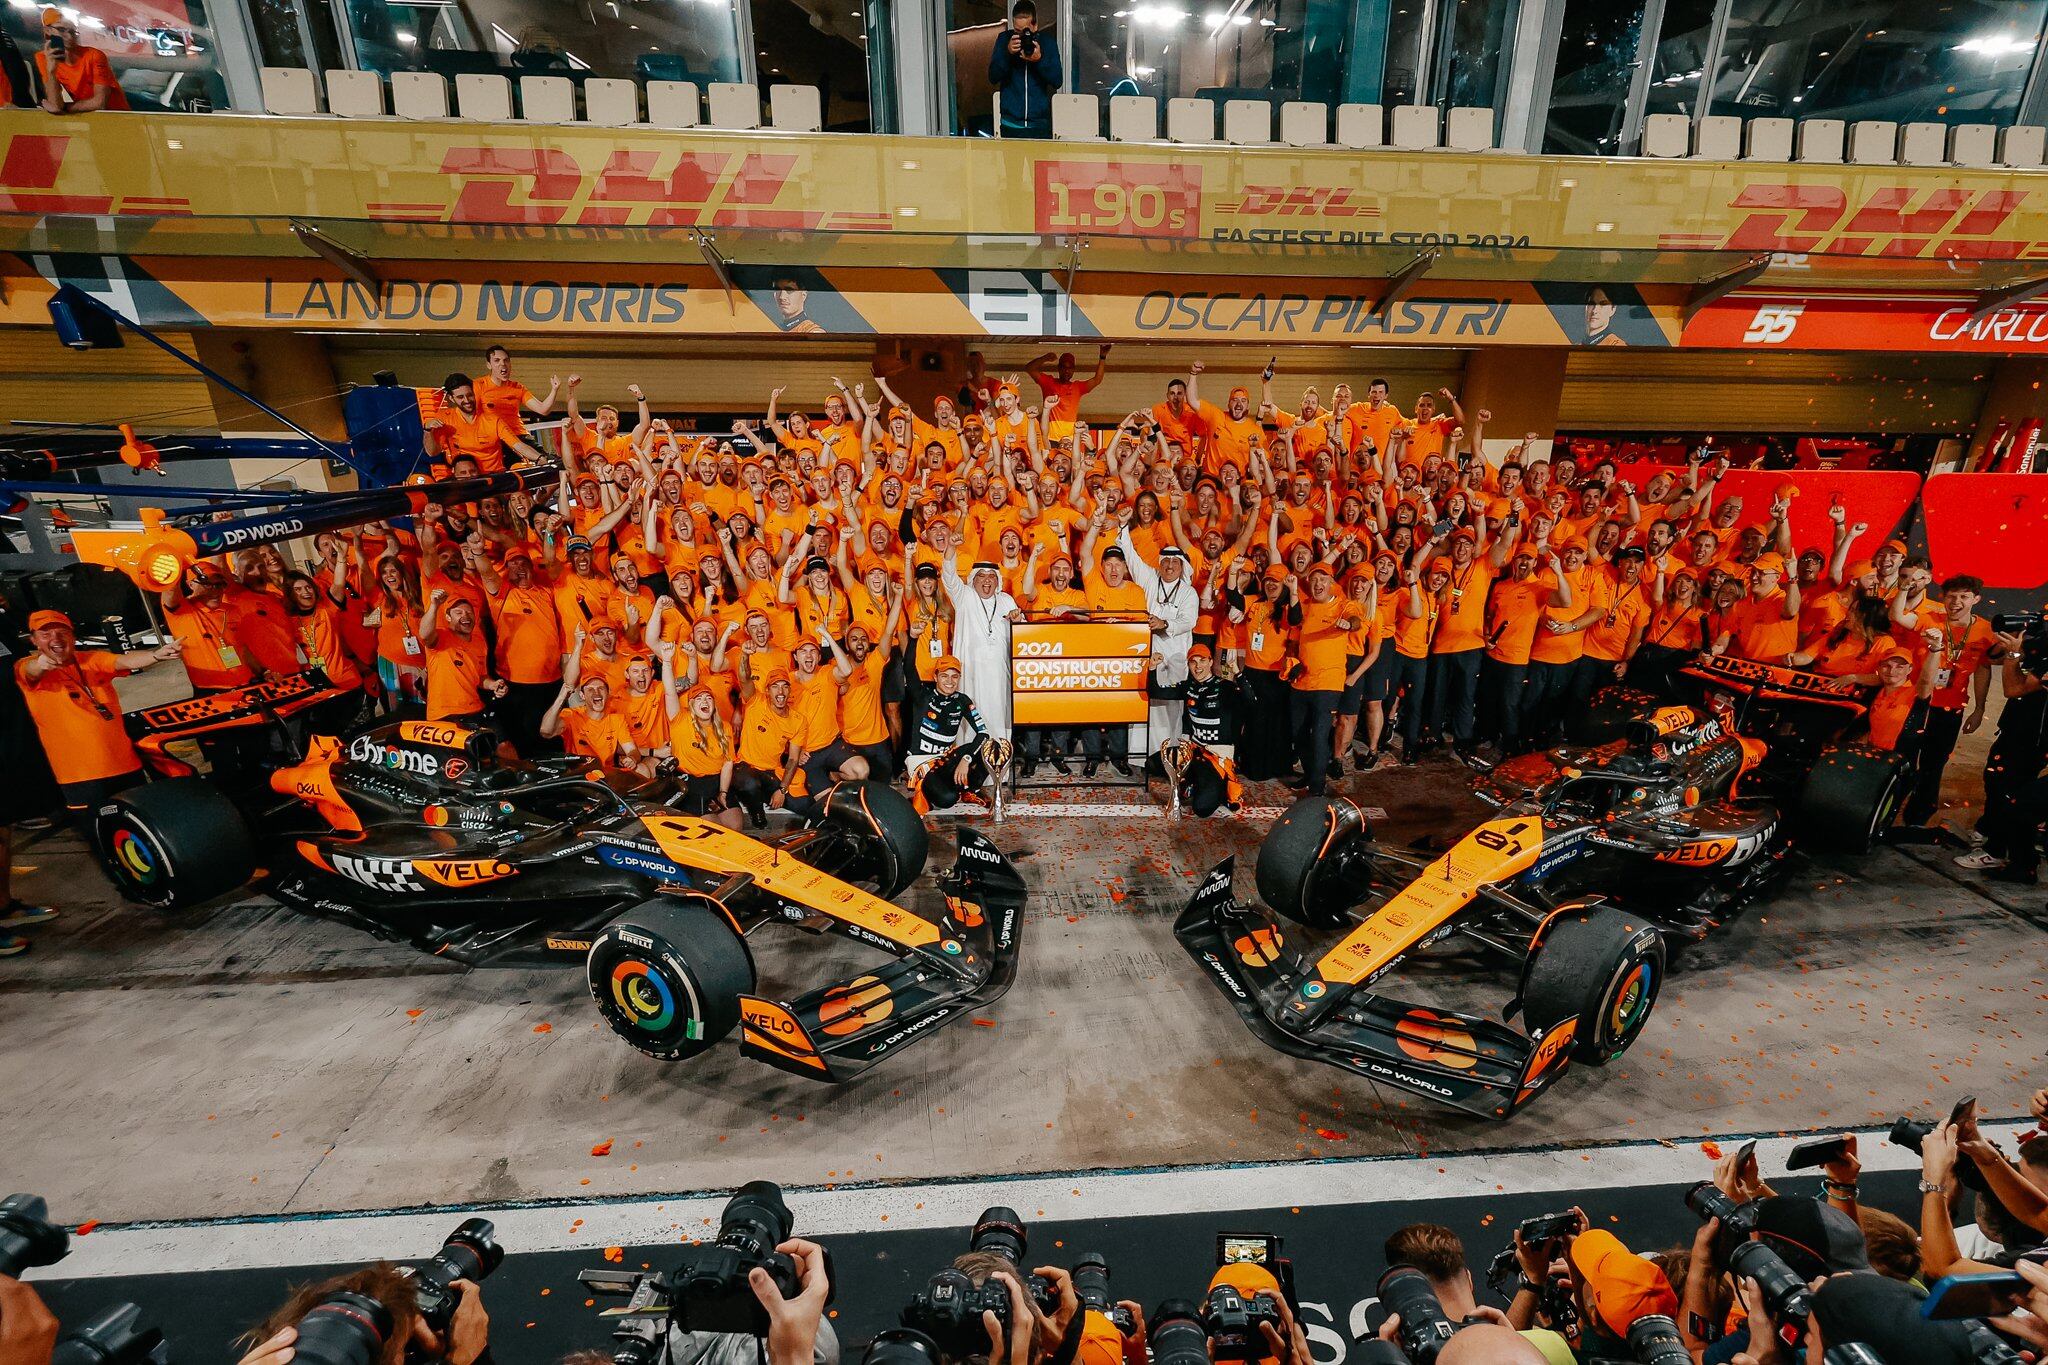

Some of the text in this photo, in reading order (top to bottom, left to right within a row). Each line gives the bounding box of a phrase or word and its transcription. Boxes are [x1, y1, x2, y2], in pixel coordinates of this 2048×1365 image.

[438, 147, 823, 229] DHL
[1237, 185, 1358, 216] DHL
[1722, 184, 2030, 259] DHL
[264, 277, 688, 323] LANDO NORRIS
[1134, 289, 1513, 336] OSCAR PIASTRI
[1743, 304, 1805, 343] 55
[223, 519, 304, 545] DP WORLD
[1017, 642, 1063, 656] 2024
[1015, 660, 1147, 675] CONSTRUCTORS'
[1015, 675, 1122, 689] CHAMPIONS
[1660, 710, 1690, 730] VELO
[413, 723, 456, 745] VELO
[350, 735, 438, 776] Chrome
[461, 821, 486, 830] CISCO
[552, 841, 594, 857] vmware
[601, 835, 662, 855] RICHARD MILLE
[1593, 836, 1635, 849] vmware
[434, 860, 515, 881] VELO
[625, 856, 676, 875] DP WORLD
[1541, 862, 1551, 873] DP
[1551, 849, 1578, 867] WORLD
[1003, 909, 1014, 932] WORLD
[618, 929, 654, 949] PIRELLI
[862, 932, 896, 950] SENNA
[1380, 955, 1406, 977] SENNA
[1211, 961, 1247, 998] DP WORLD
[745, 1011, 795, 1035] VELO
[886, 1008, 950, 1045] DP WORLD
[1538, 1033, 1572, 1062] VELO
[1370, 1064, 1453, 1097] DP WORLD
